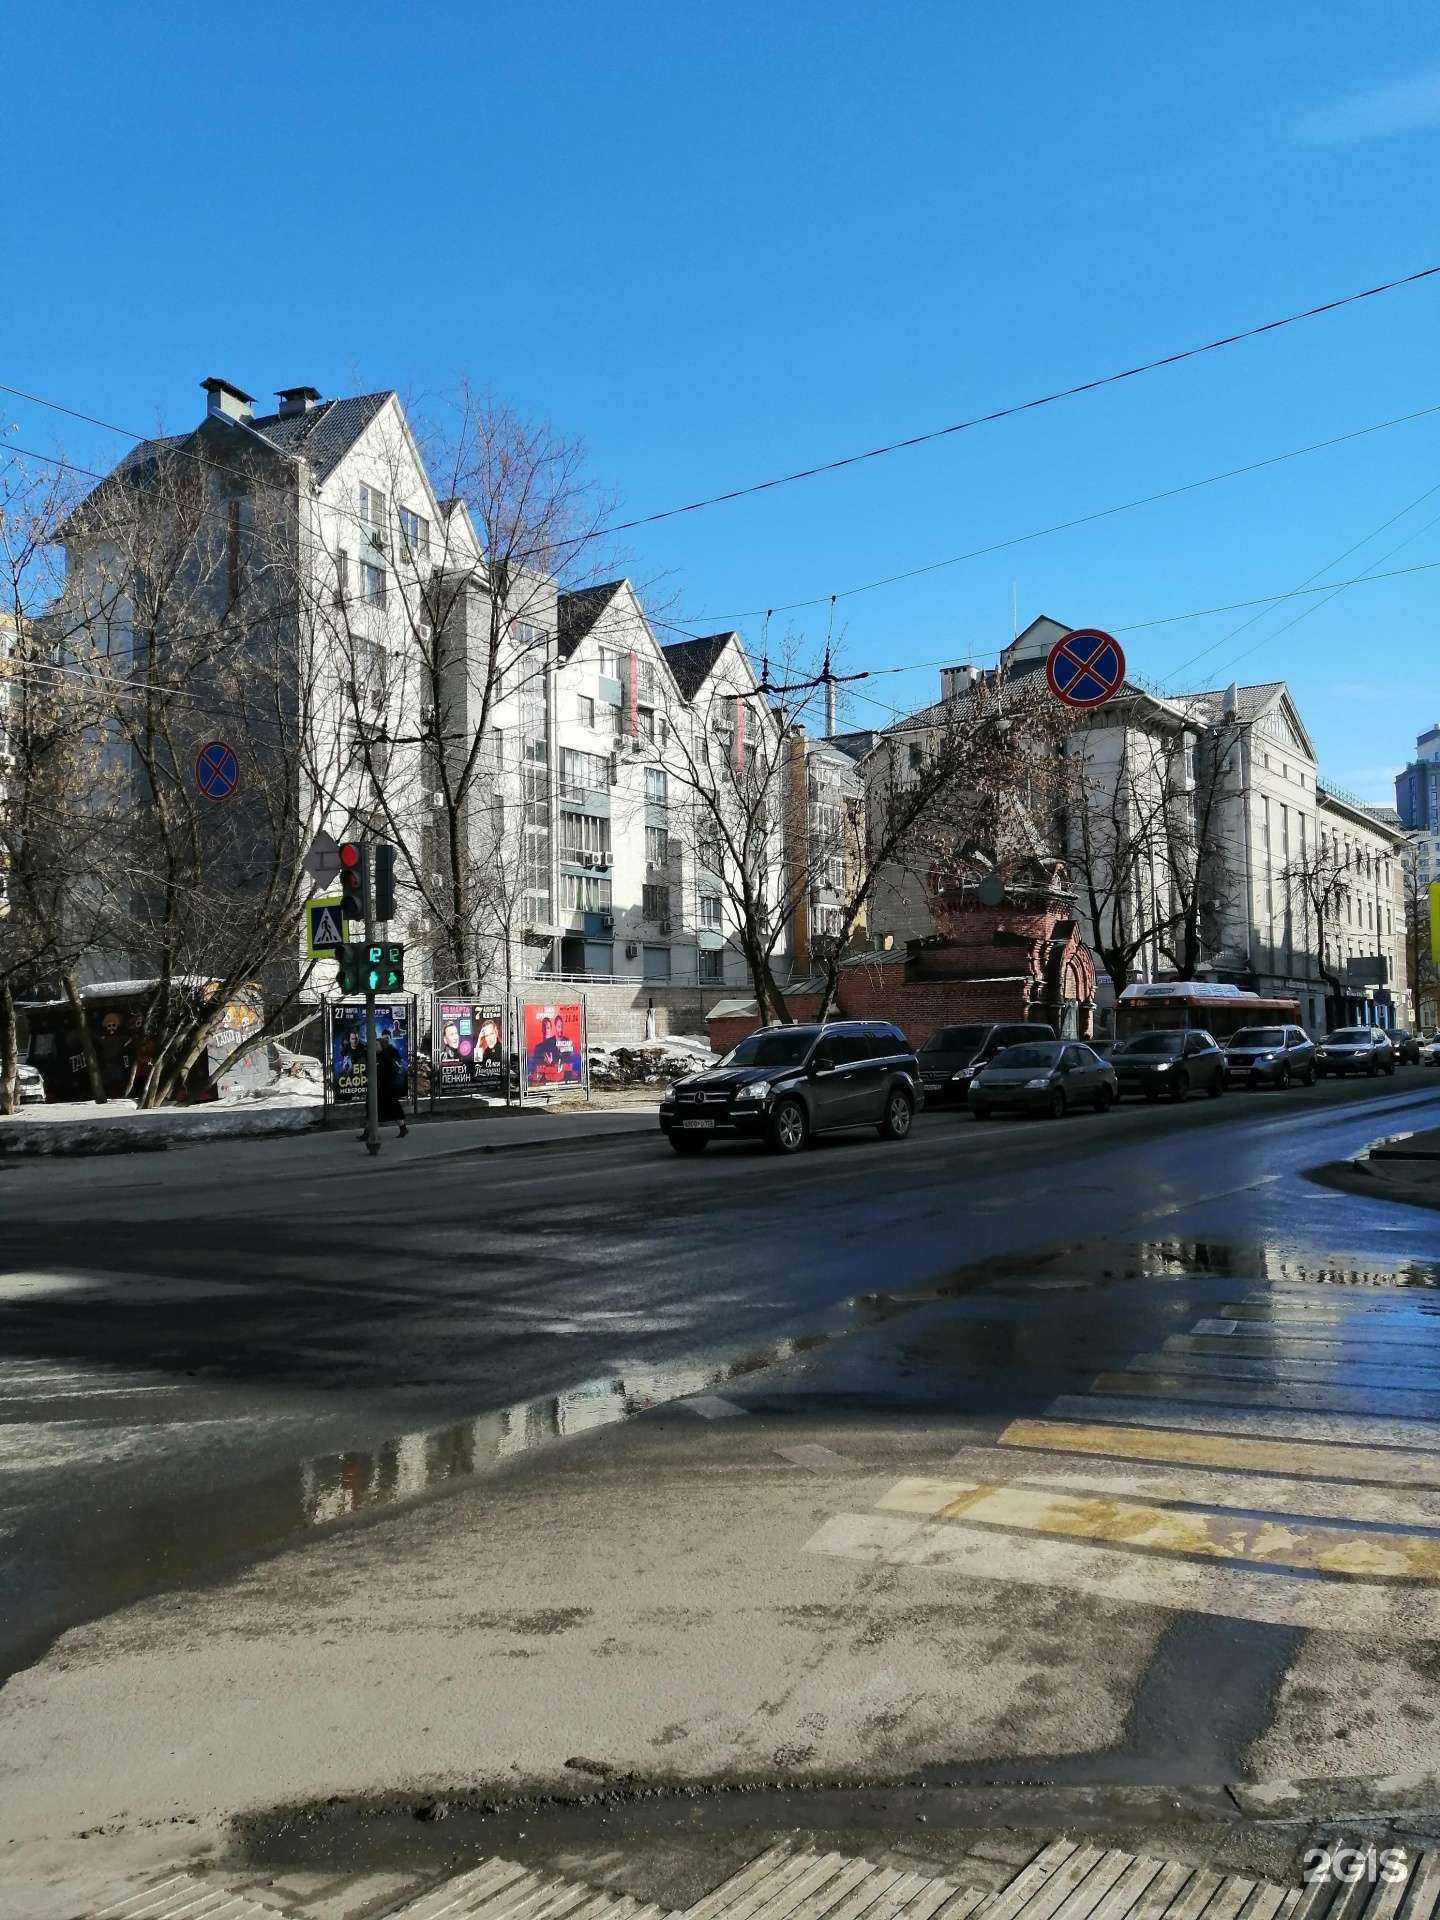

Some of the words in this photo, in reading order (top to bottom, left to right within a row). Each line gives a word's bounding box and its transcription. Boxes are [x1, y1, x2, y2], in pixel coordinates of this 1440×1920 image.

[335, 1008, 344, 1018] 27
[475, 1007, 483, 1019] 7
[442, 1064, 467, 1074] СЕРГЕЙ
[338, 1076, 368, 1088] САФР
[442, 1073, 471, 1084] ПЕНКИН
